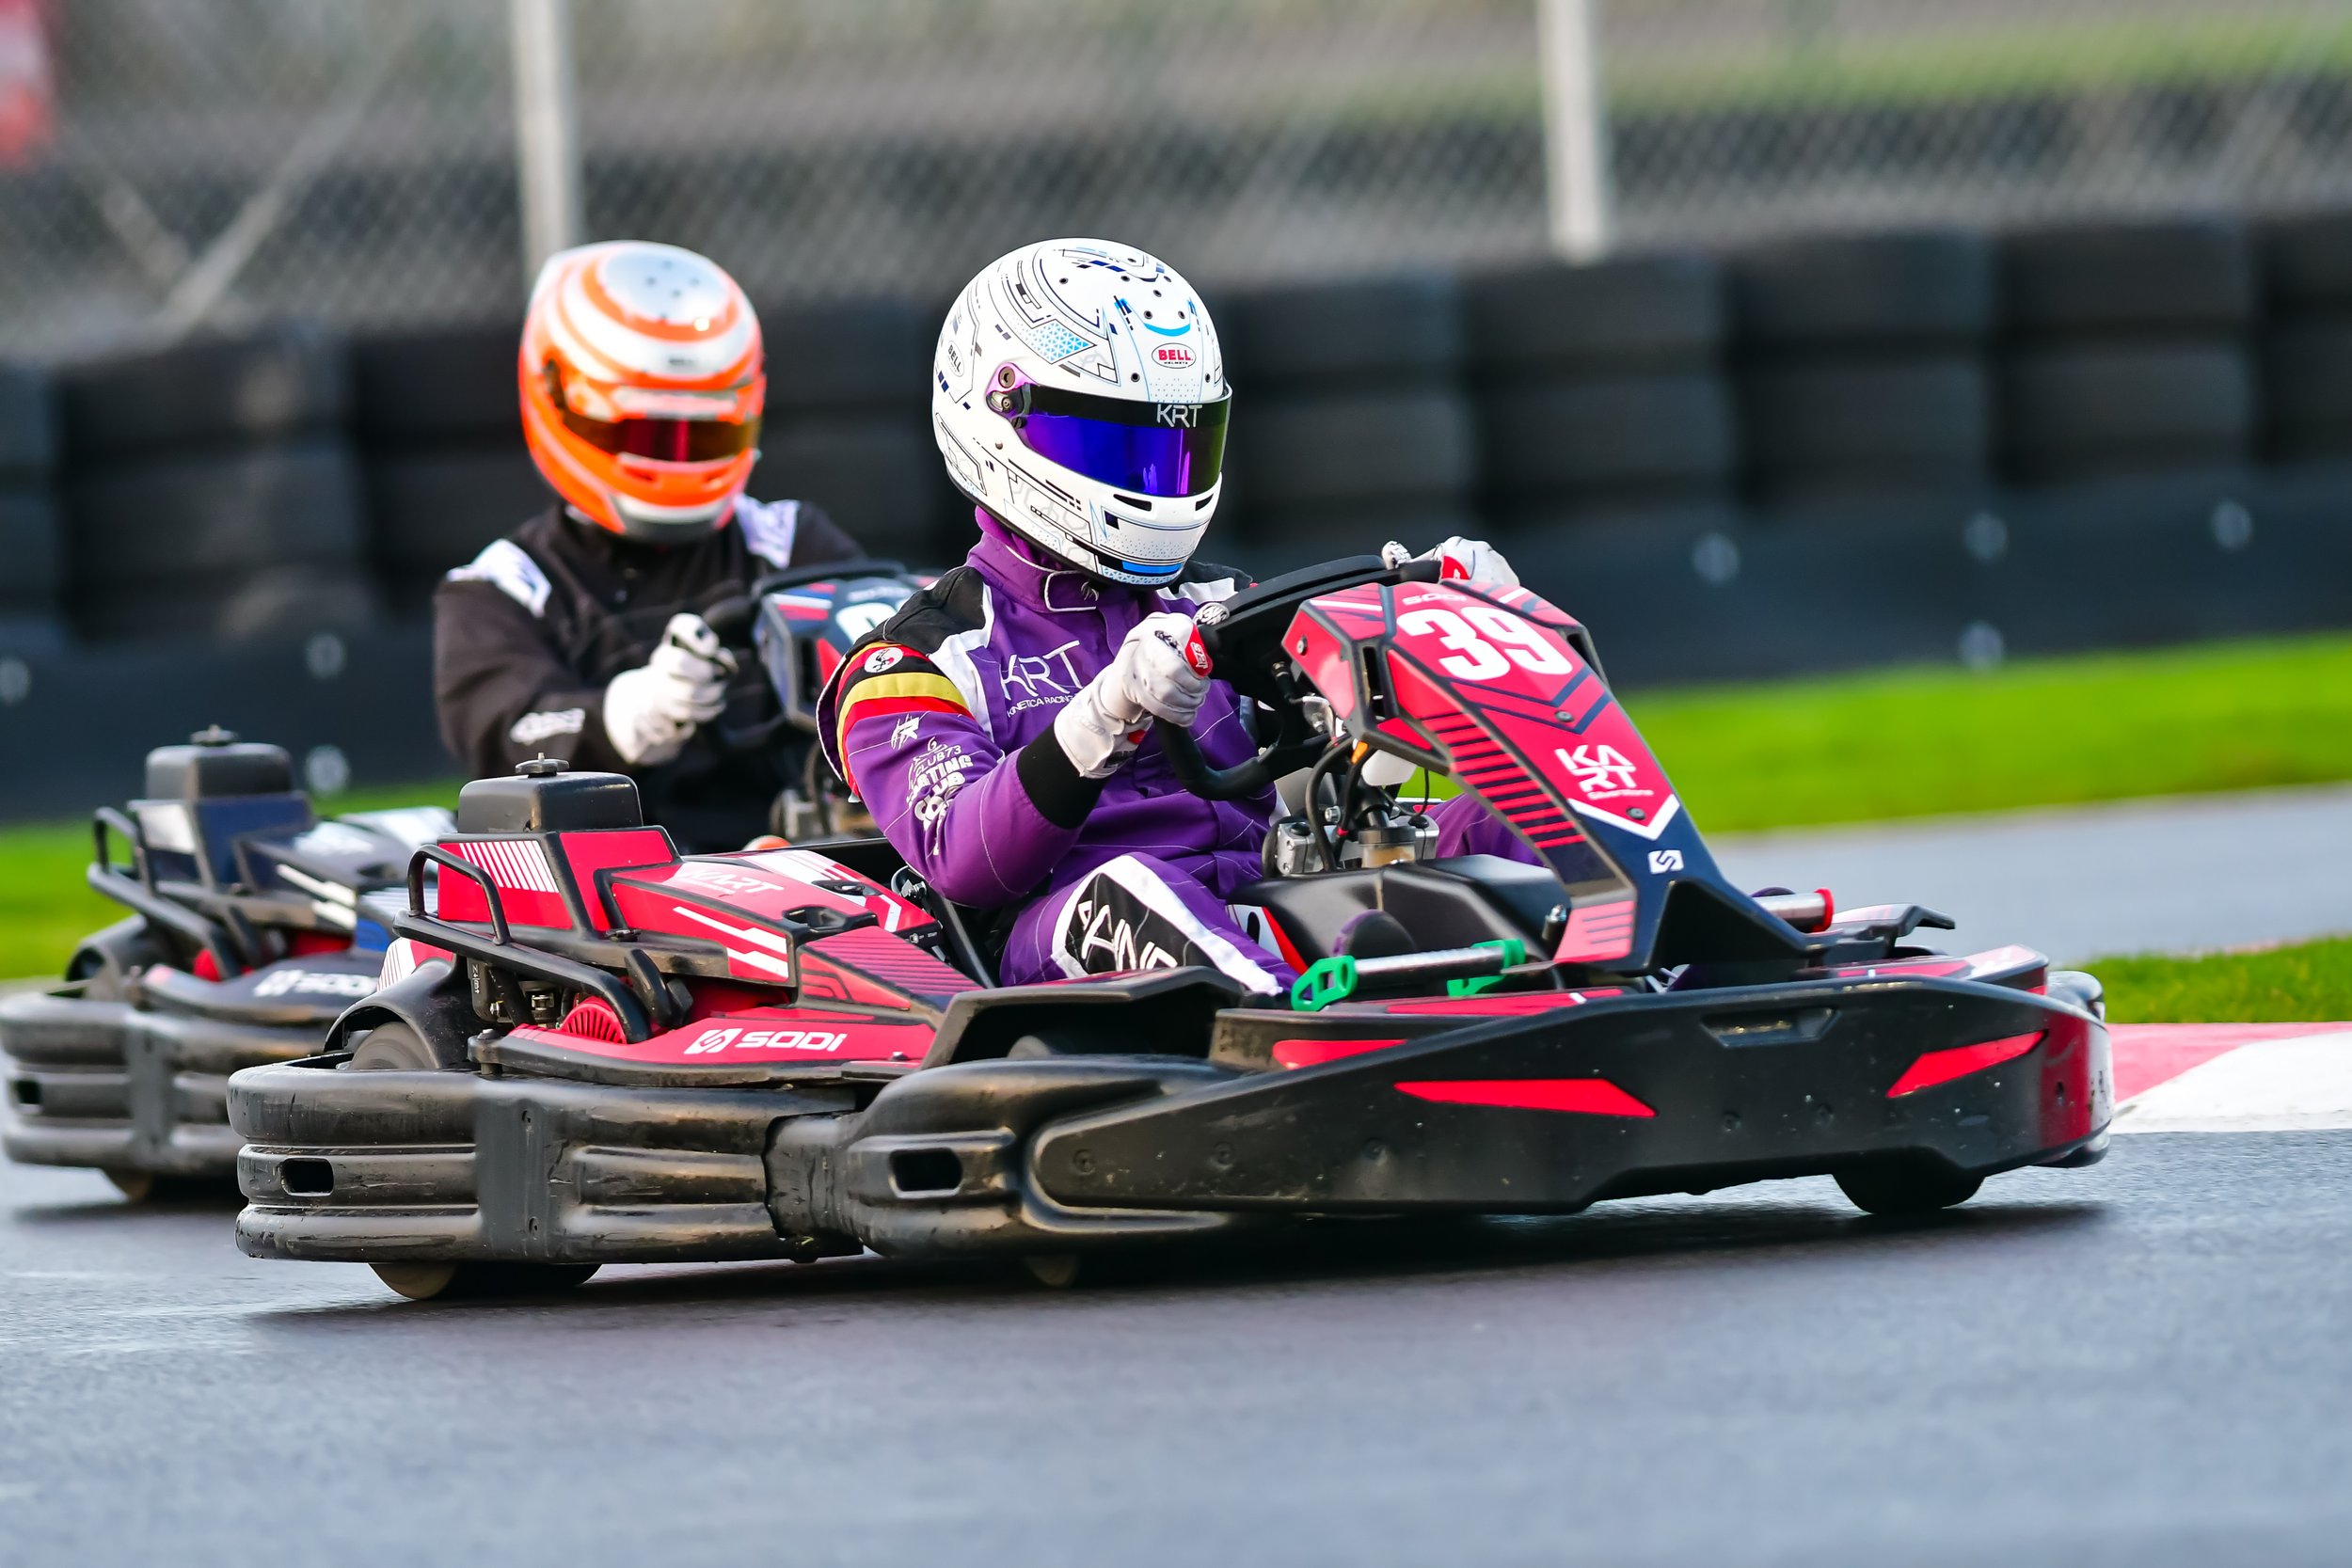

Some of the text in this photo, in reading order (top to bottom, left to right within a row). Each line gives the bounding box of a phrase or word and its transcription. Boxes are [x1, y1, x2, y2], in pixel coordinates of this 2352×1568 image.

[948, 344, 961, 372] BELL
[1158, 349, 1193, 361] BELL
[1156, 404, 1202, 428] KRT
[1396, 606, 1573, 681] 39
[999, 640, 1084, 701] KRT
[735, 1031, 848, 1052] SODI
